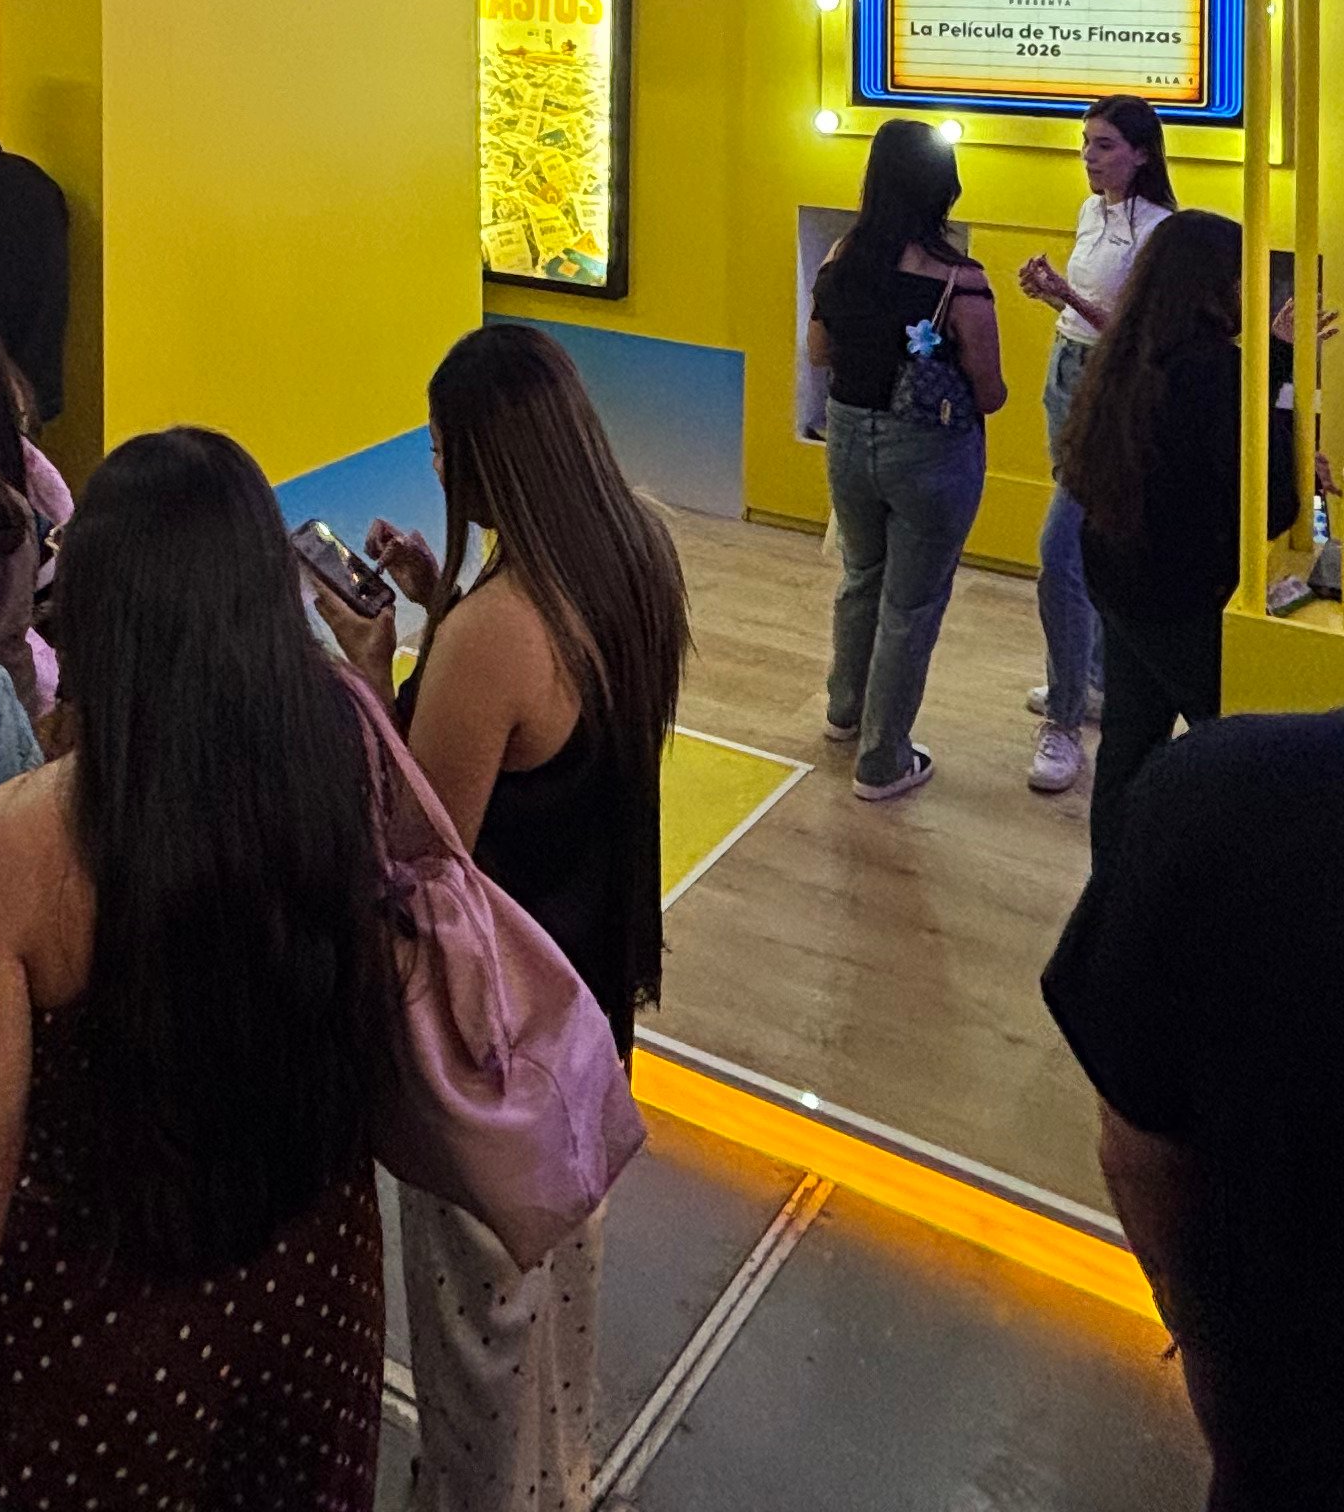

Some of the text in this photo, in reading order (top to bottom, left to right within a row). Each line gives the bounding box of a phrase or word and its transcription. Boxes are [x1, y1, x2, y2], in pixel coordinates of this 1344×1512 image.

[910, 21, 1182, 44] La Película de Tus Finanzas
[1016, 43, 1062, 57] 2026
[1146, 76, 1180, 85] SALA
